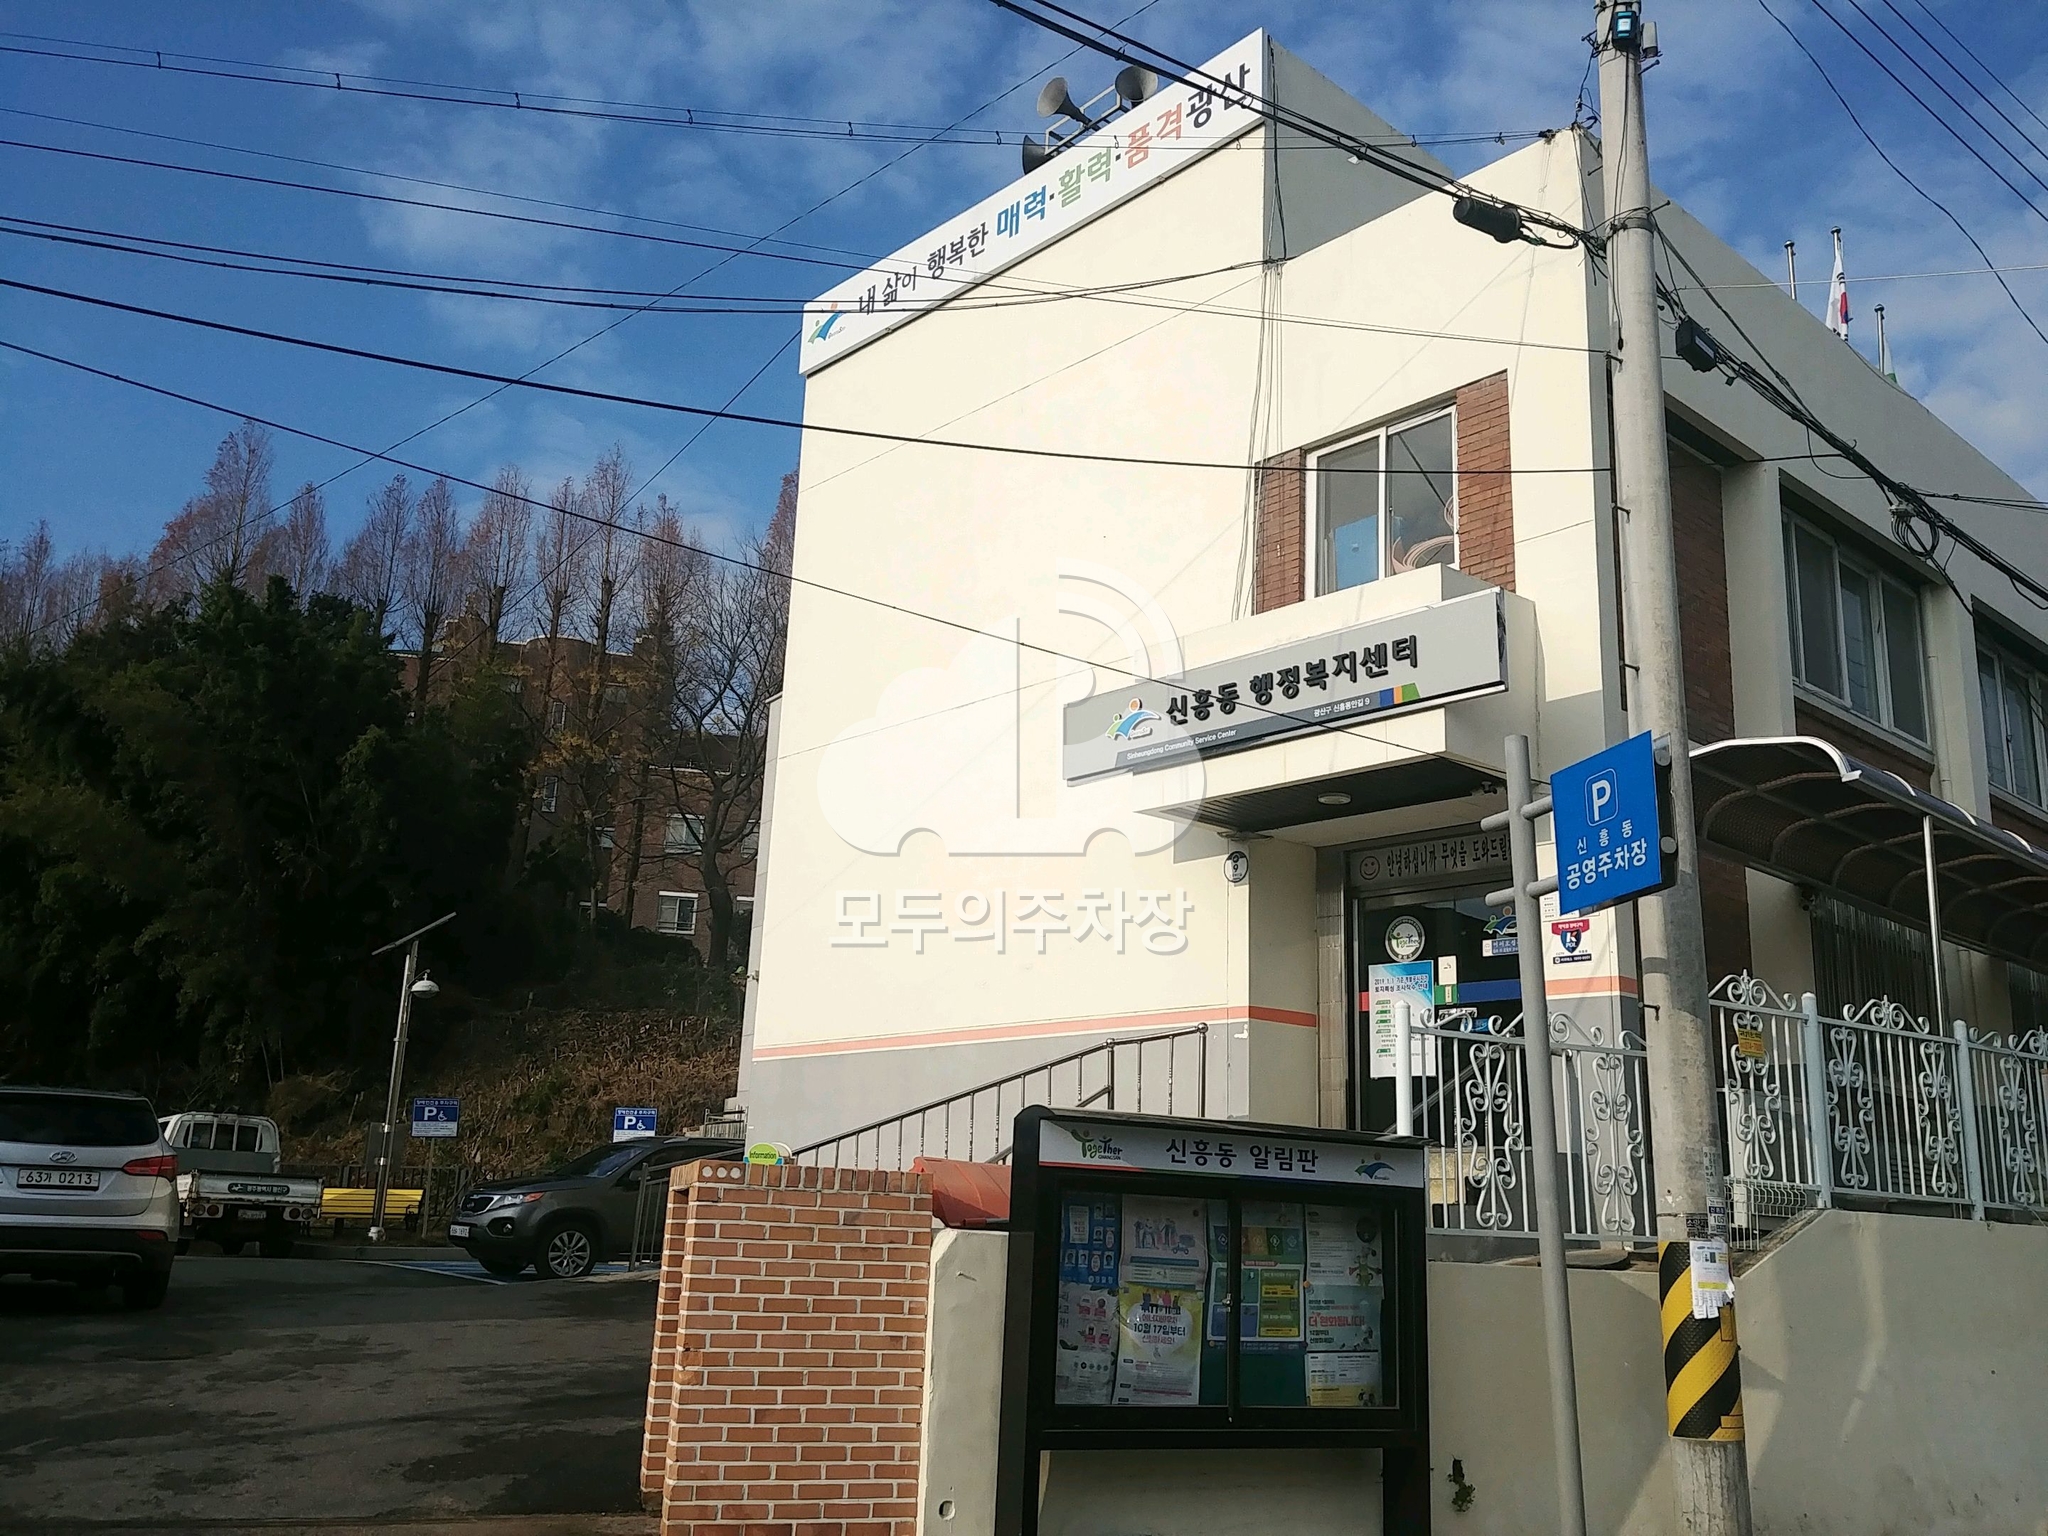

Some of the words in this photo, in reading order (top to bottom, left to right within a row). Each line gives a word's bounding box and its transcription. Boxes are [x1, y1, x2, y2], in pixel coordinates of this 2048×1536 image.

[882, 265, 918, 307] 삶이
[927, 222, 989, 280] 행복한
[1166, 682, 1240, 726] 신흥동
[1250, 634, 1418, 706] 행정복지센터
[1313, 706, 1332, 718] 광산구
[1365, 697, 1371, 706] 9
[1126, 744, 1164, 760] Sinheungdong
[1165, 739, 1195, 752] Community
[1195, 734, 1217, 745] Service
[1217, 729, 1237, 740] Center
[1591, 778, 1612, 822] P
[1386, 843, 1438, 878] 안녕하십니까
[1441, 839, 1468, 870] 무엇을
[1566, 837, 1648, 891] 공영주차장
[423, 1106, 437, 1121] P
[623, 1116, 637, 1130] P
[1165, 1137, 1238, 1168] 신흥동
[1249, 1144, 1319, 1174] 알림판
[25, 1171, 52, 1183] 63가
[58, 1172, 93, 1185] 0213
[1133, 1322, 1152, 1334] 10월
[1152, 1324, 1186, 1337] 17일부터
